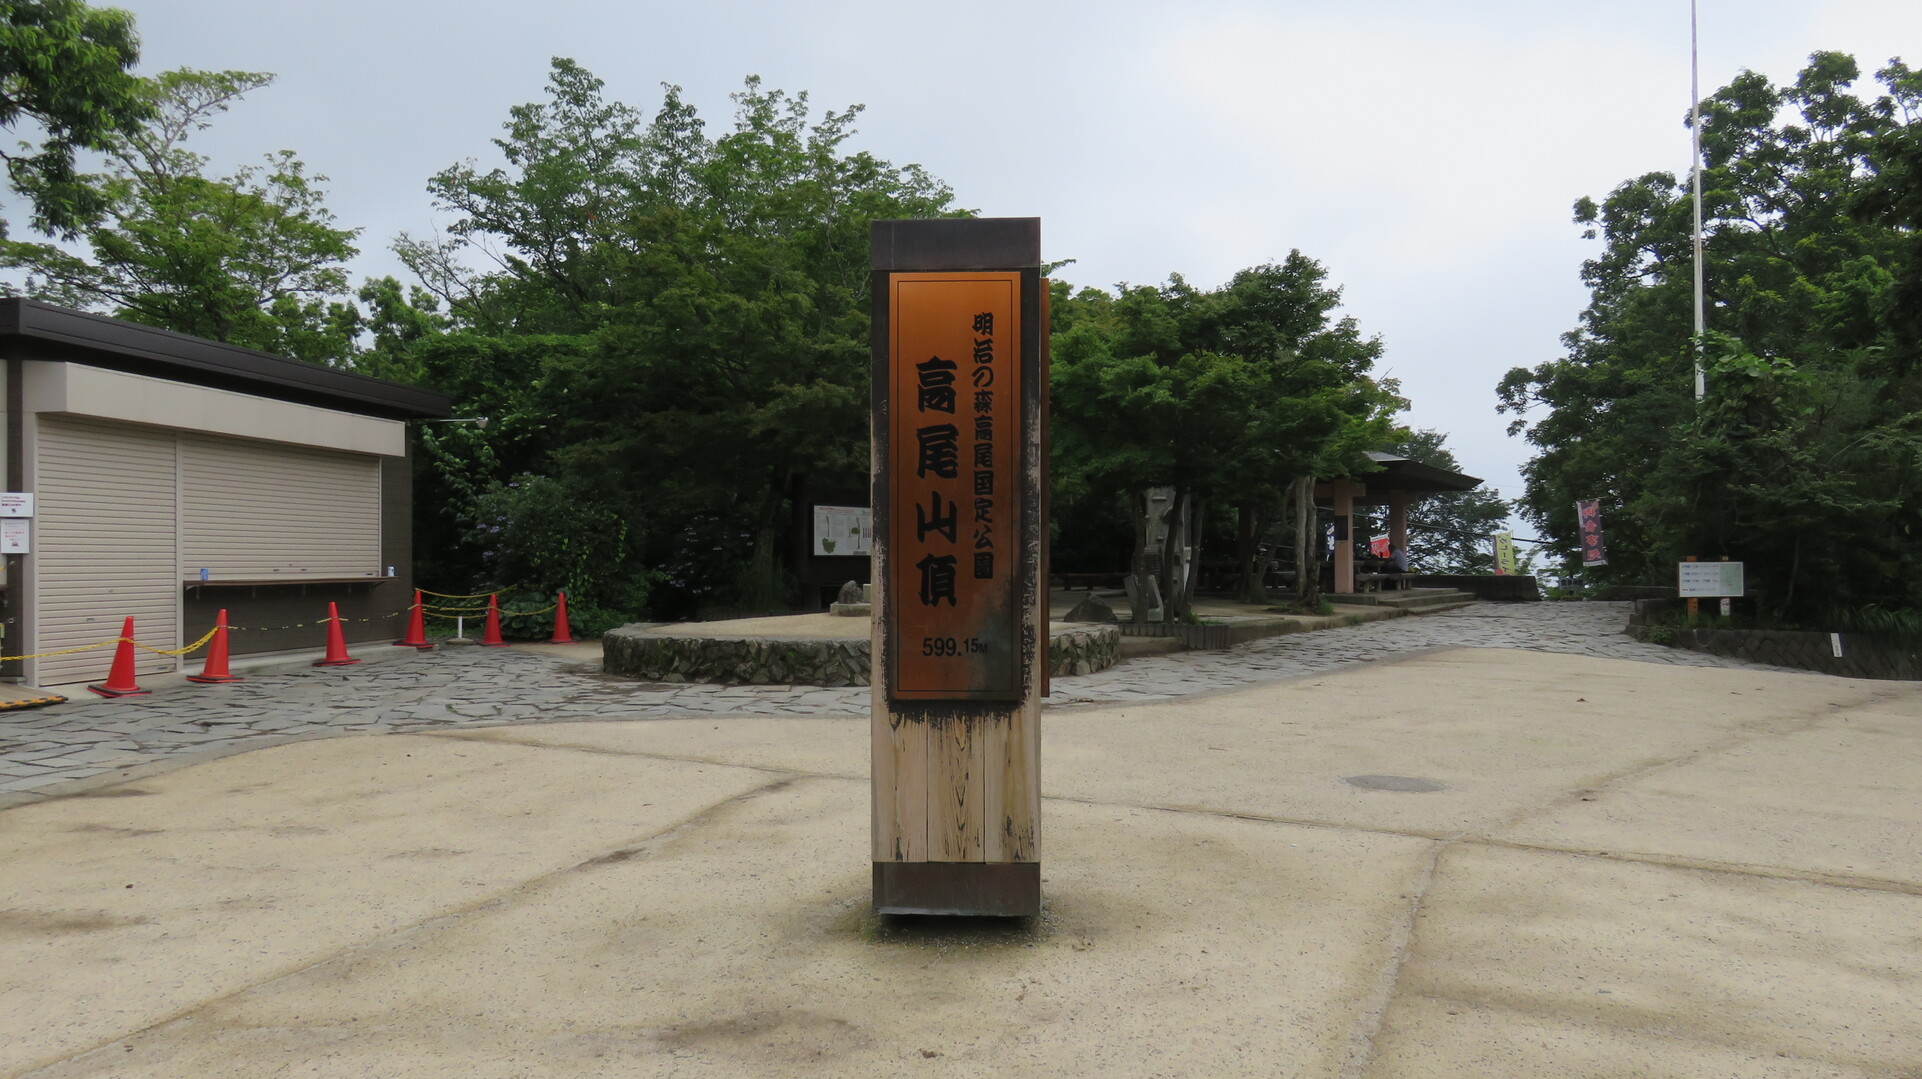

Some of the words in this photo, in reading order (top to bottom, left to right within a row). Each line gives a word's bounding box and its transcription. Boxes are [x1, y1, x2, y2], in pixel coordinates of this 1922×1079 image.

[916, 355, 959, 607] 高尾山頂
[971, 311, 994, 580] 明治の森高尾国定公園
